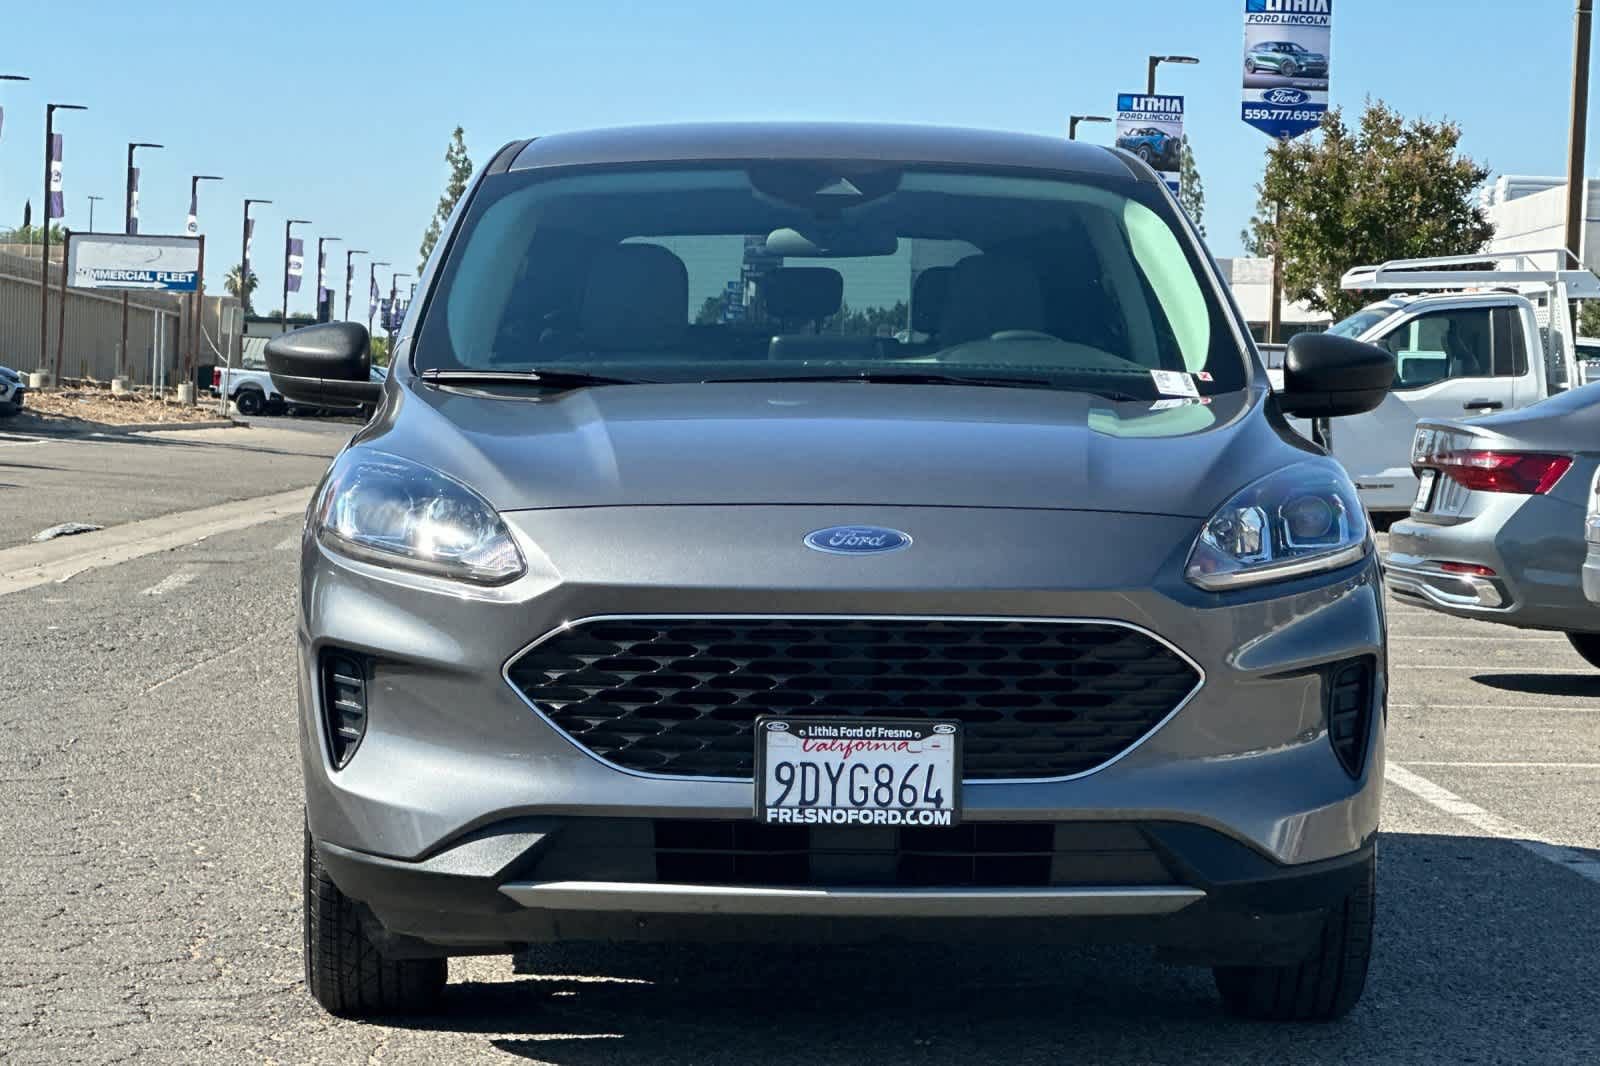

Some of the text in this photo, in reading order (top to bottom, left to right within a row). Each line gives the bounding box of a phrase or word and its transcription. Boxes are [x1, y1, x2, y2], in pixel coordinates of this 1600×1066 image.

[1265, 0, 1329, 13] LITHIA
[1247, 14, 1328, 25] FORD LINCOLN
[1270, 89, 1301, 104] Ford
[1132, 96, 1181, 113] LITHIA
[1119, 112, 1181, 121] FORD LINCOLN
[78, 268, 195, 283] MMERCIAL FLEET
[829, 529, 887, 547] Ford
[808, 726, 912, 739] Lithia Ford of Fresno
[802, 736, 922, 759] California
[774, 761, 944, 809] 9DYG864
[766, 808, 951, 825] FRESNOFORD.COM
